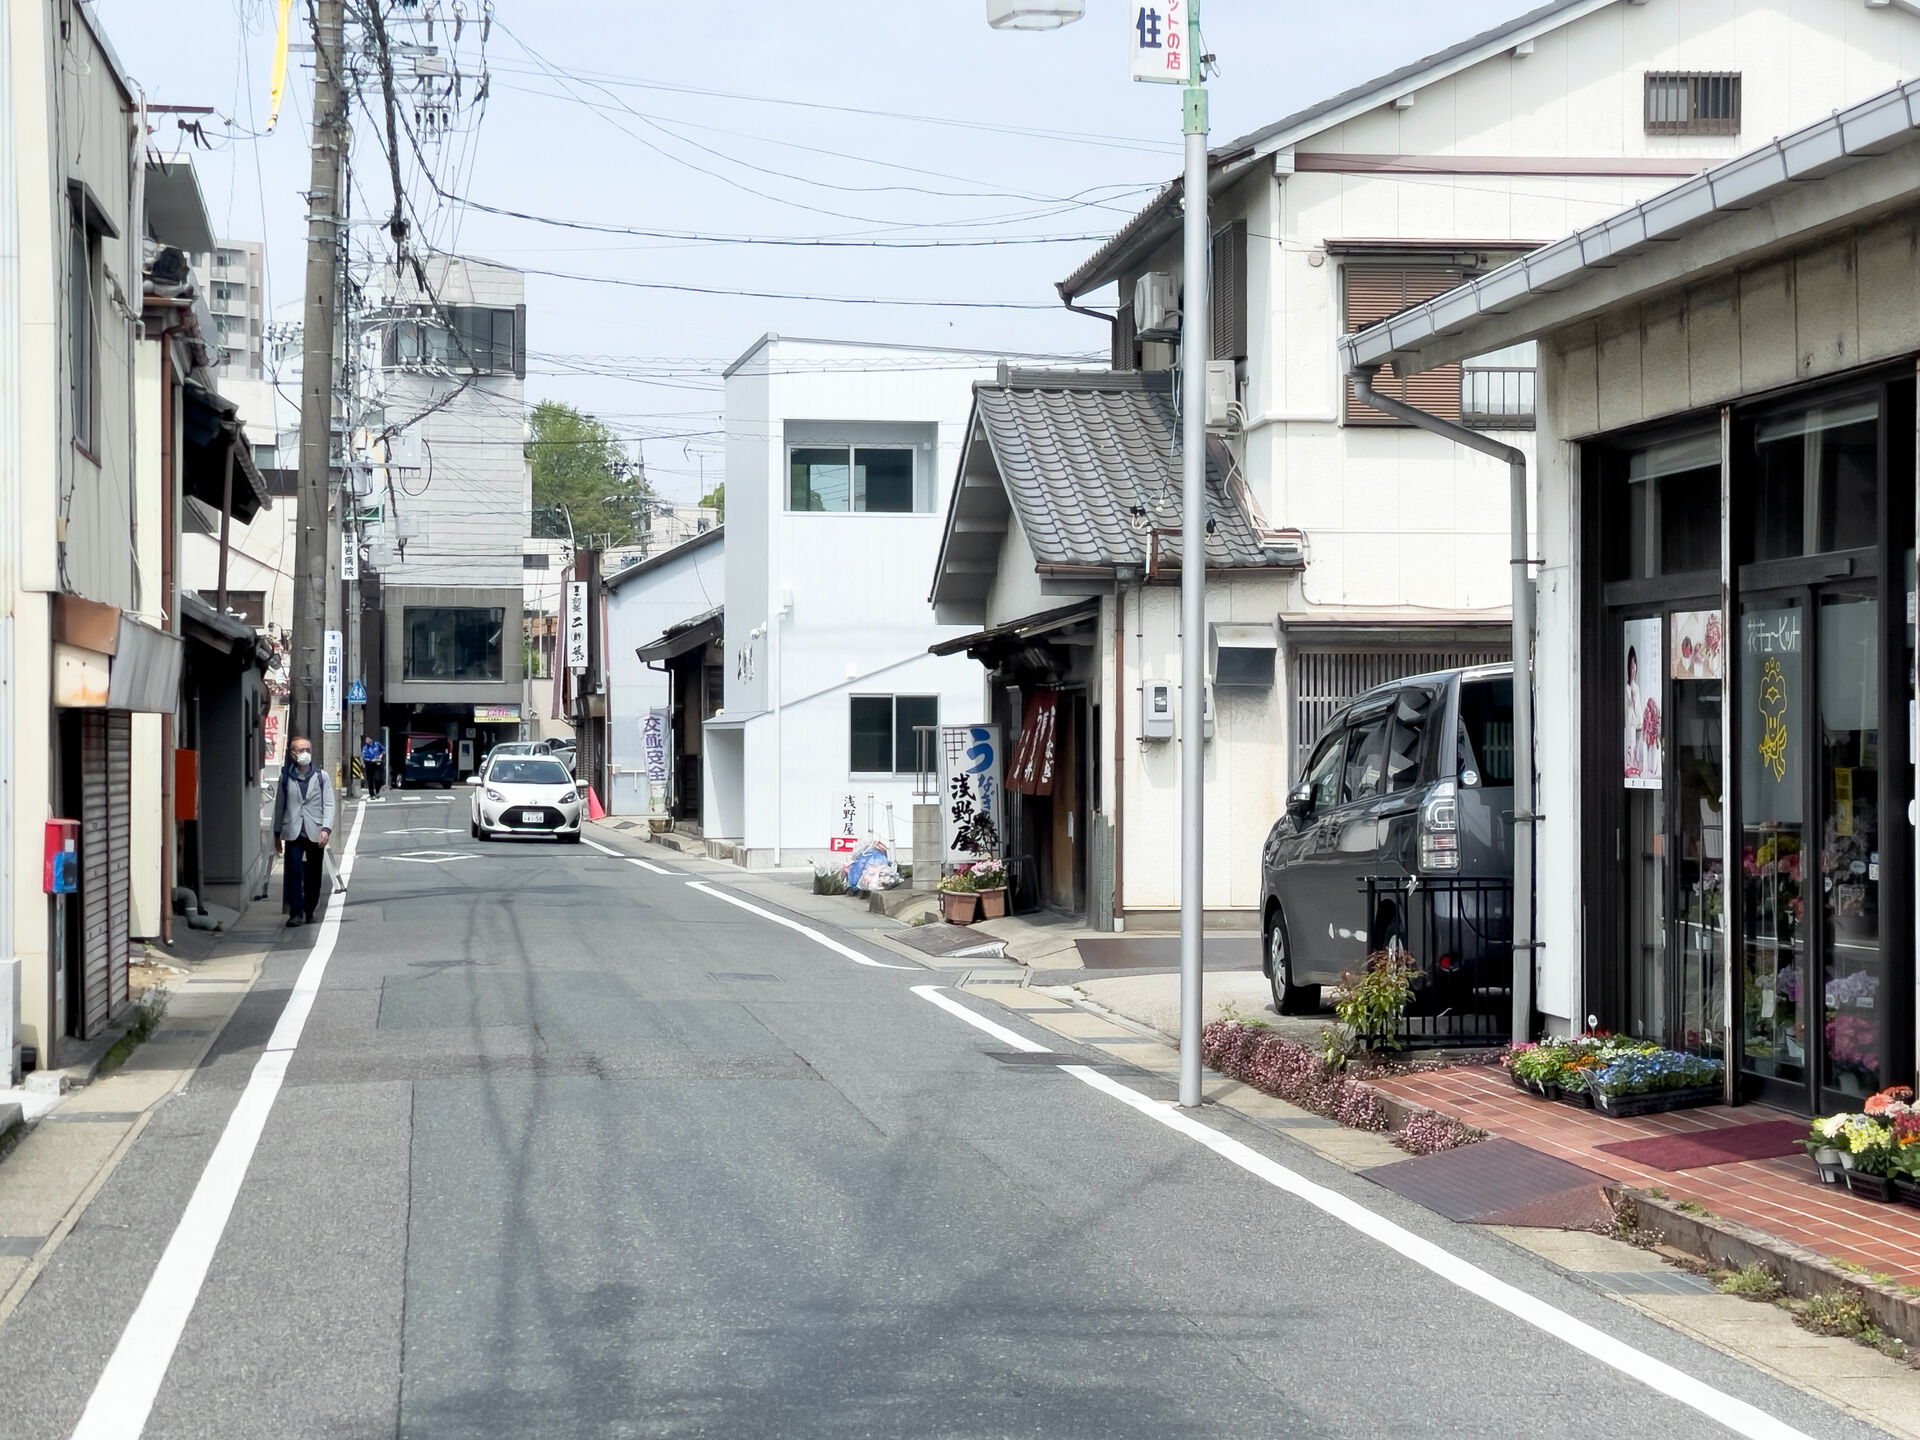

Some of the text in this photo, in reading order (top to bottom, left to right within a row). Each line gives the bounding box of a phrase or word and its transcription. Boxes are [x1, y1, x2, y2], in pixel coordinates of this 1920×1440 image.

[344, 534, 354, 577] 平岩病院
[842, 795, 856, 836] 浅野屋
[834, 839, 844, 850] P
